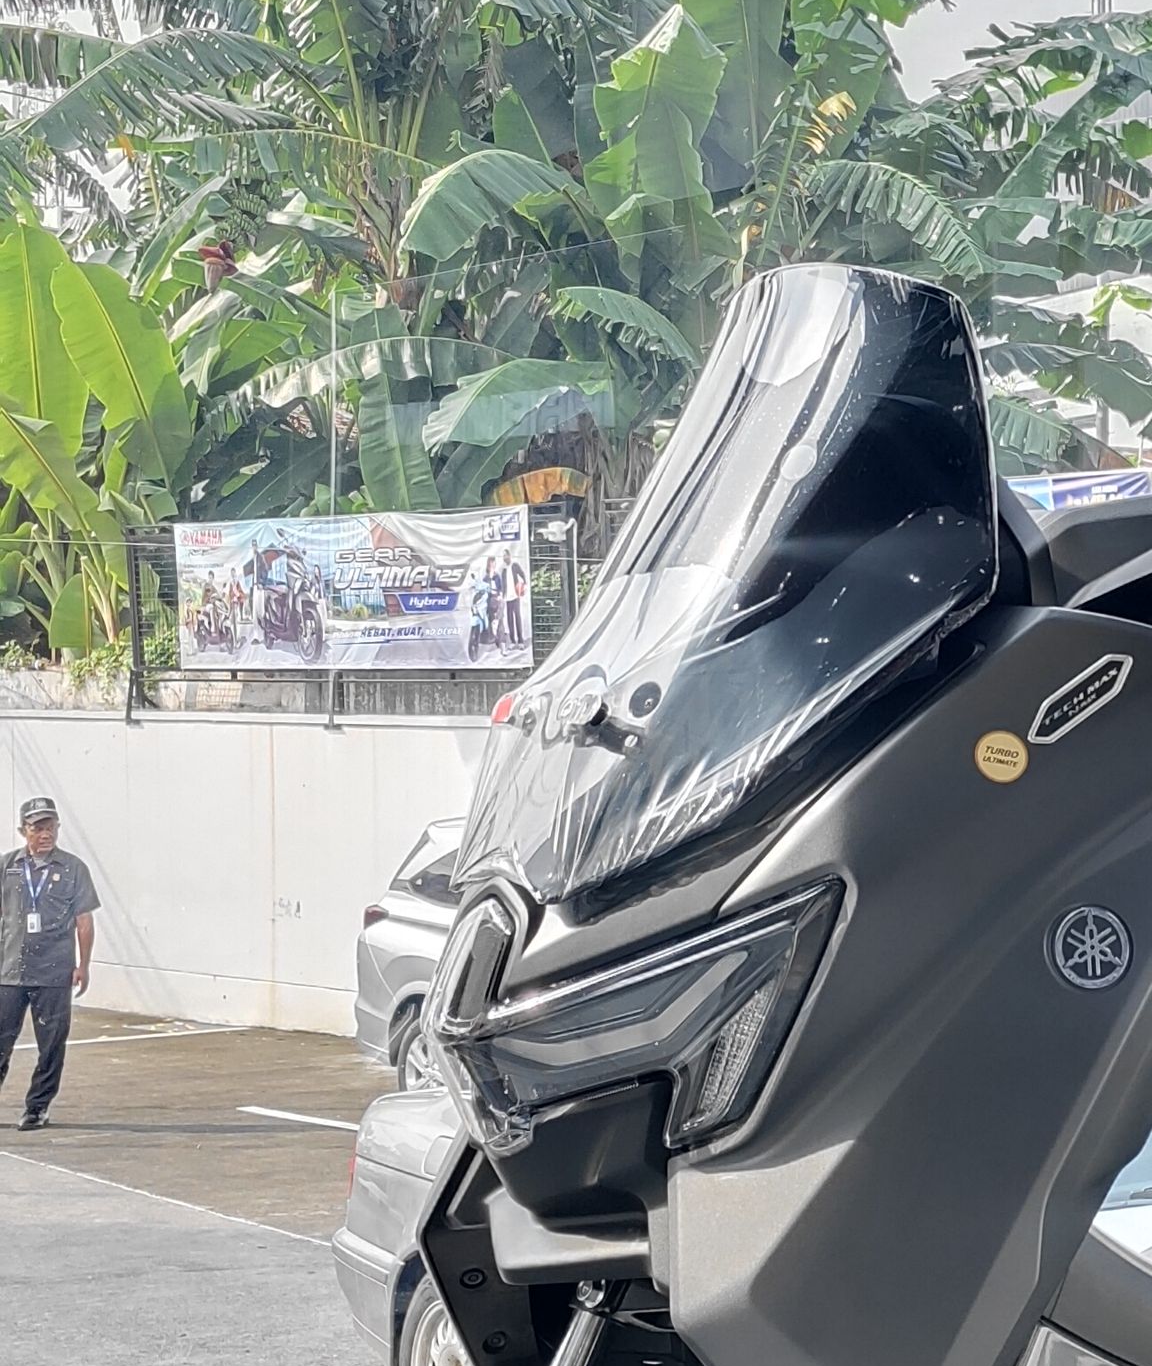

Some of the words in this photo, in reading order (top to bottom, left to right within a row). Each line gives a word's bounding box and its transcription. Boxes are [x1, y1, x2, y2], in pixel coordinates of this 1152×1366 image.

[335, 546, 412, 563] GEAR
[334, 565, 432, 589] ULTIMA
[435, 568, 465, 583] 125
[409, 595, 449, 609] Hybrid
[1041, 691, 1085, 726] TECH
[1087, 667, 1119, 696] MAX
[985, 745, 1020, 759] TURBO
[983, 755, 1019, 768] ULTIMATE
